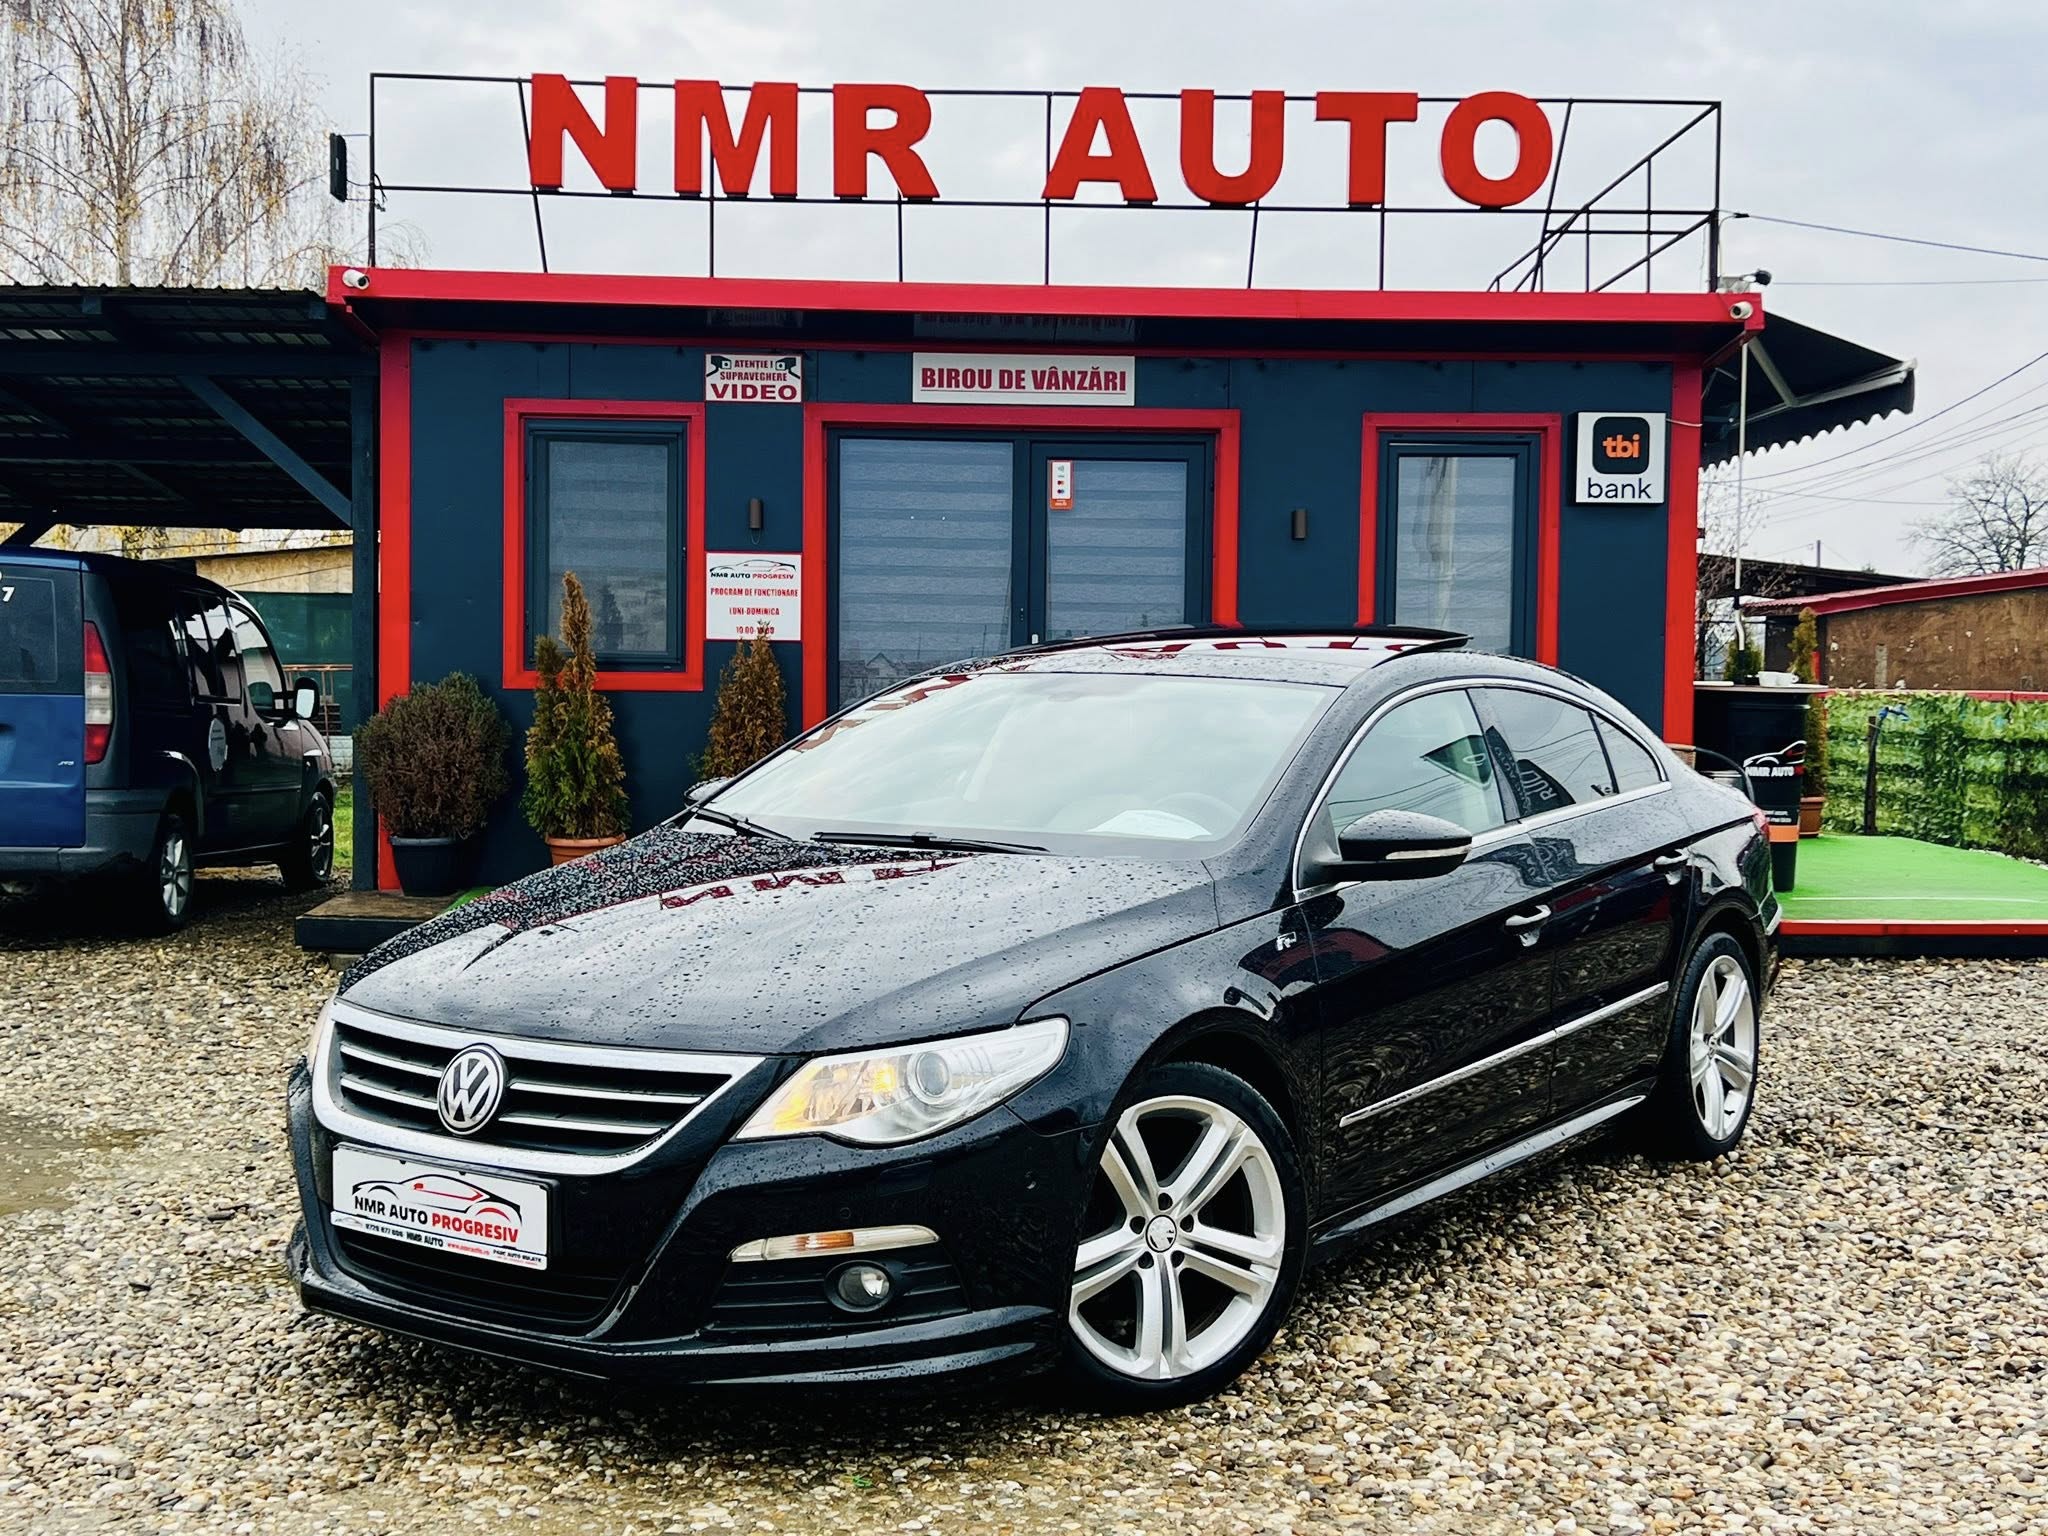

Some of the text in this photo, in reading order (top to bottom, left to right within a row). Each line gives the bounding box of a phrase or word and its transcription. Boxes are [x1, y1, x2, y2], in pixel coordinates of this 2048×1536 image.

[530, 73, 1554, 207] NMR AUTO
[720, 371, 787, 382] SUPRAVEGHERE
[921, 366, 1127, 391] BIROU DE VÂNZĂRI
[710, 383, 798, 401] VIDEO
[1602, 433, 1640, 458] tbi
[1587, 477, 1652, 499] bank
[710, 588, 743, 597] PROGRAM
[744, 588, 752, 597] DE
[1771, 766, 1794, 777] AUTO
[439, 1047, 502, 1132] VW
[354, 1195, 519, 1244] NMR AUTO PROGRESIV
[424, 1235, 444, 1248] AUTO
